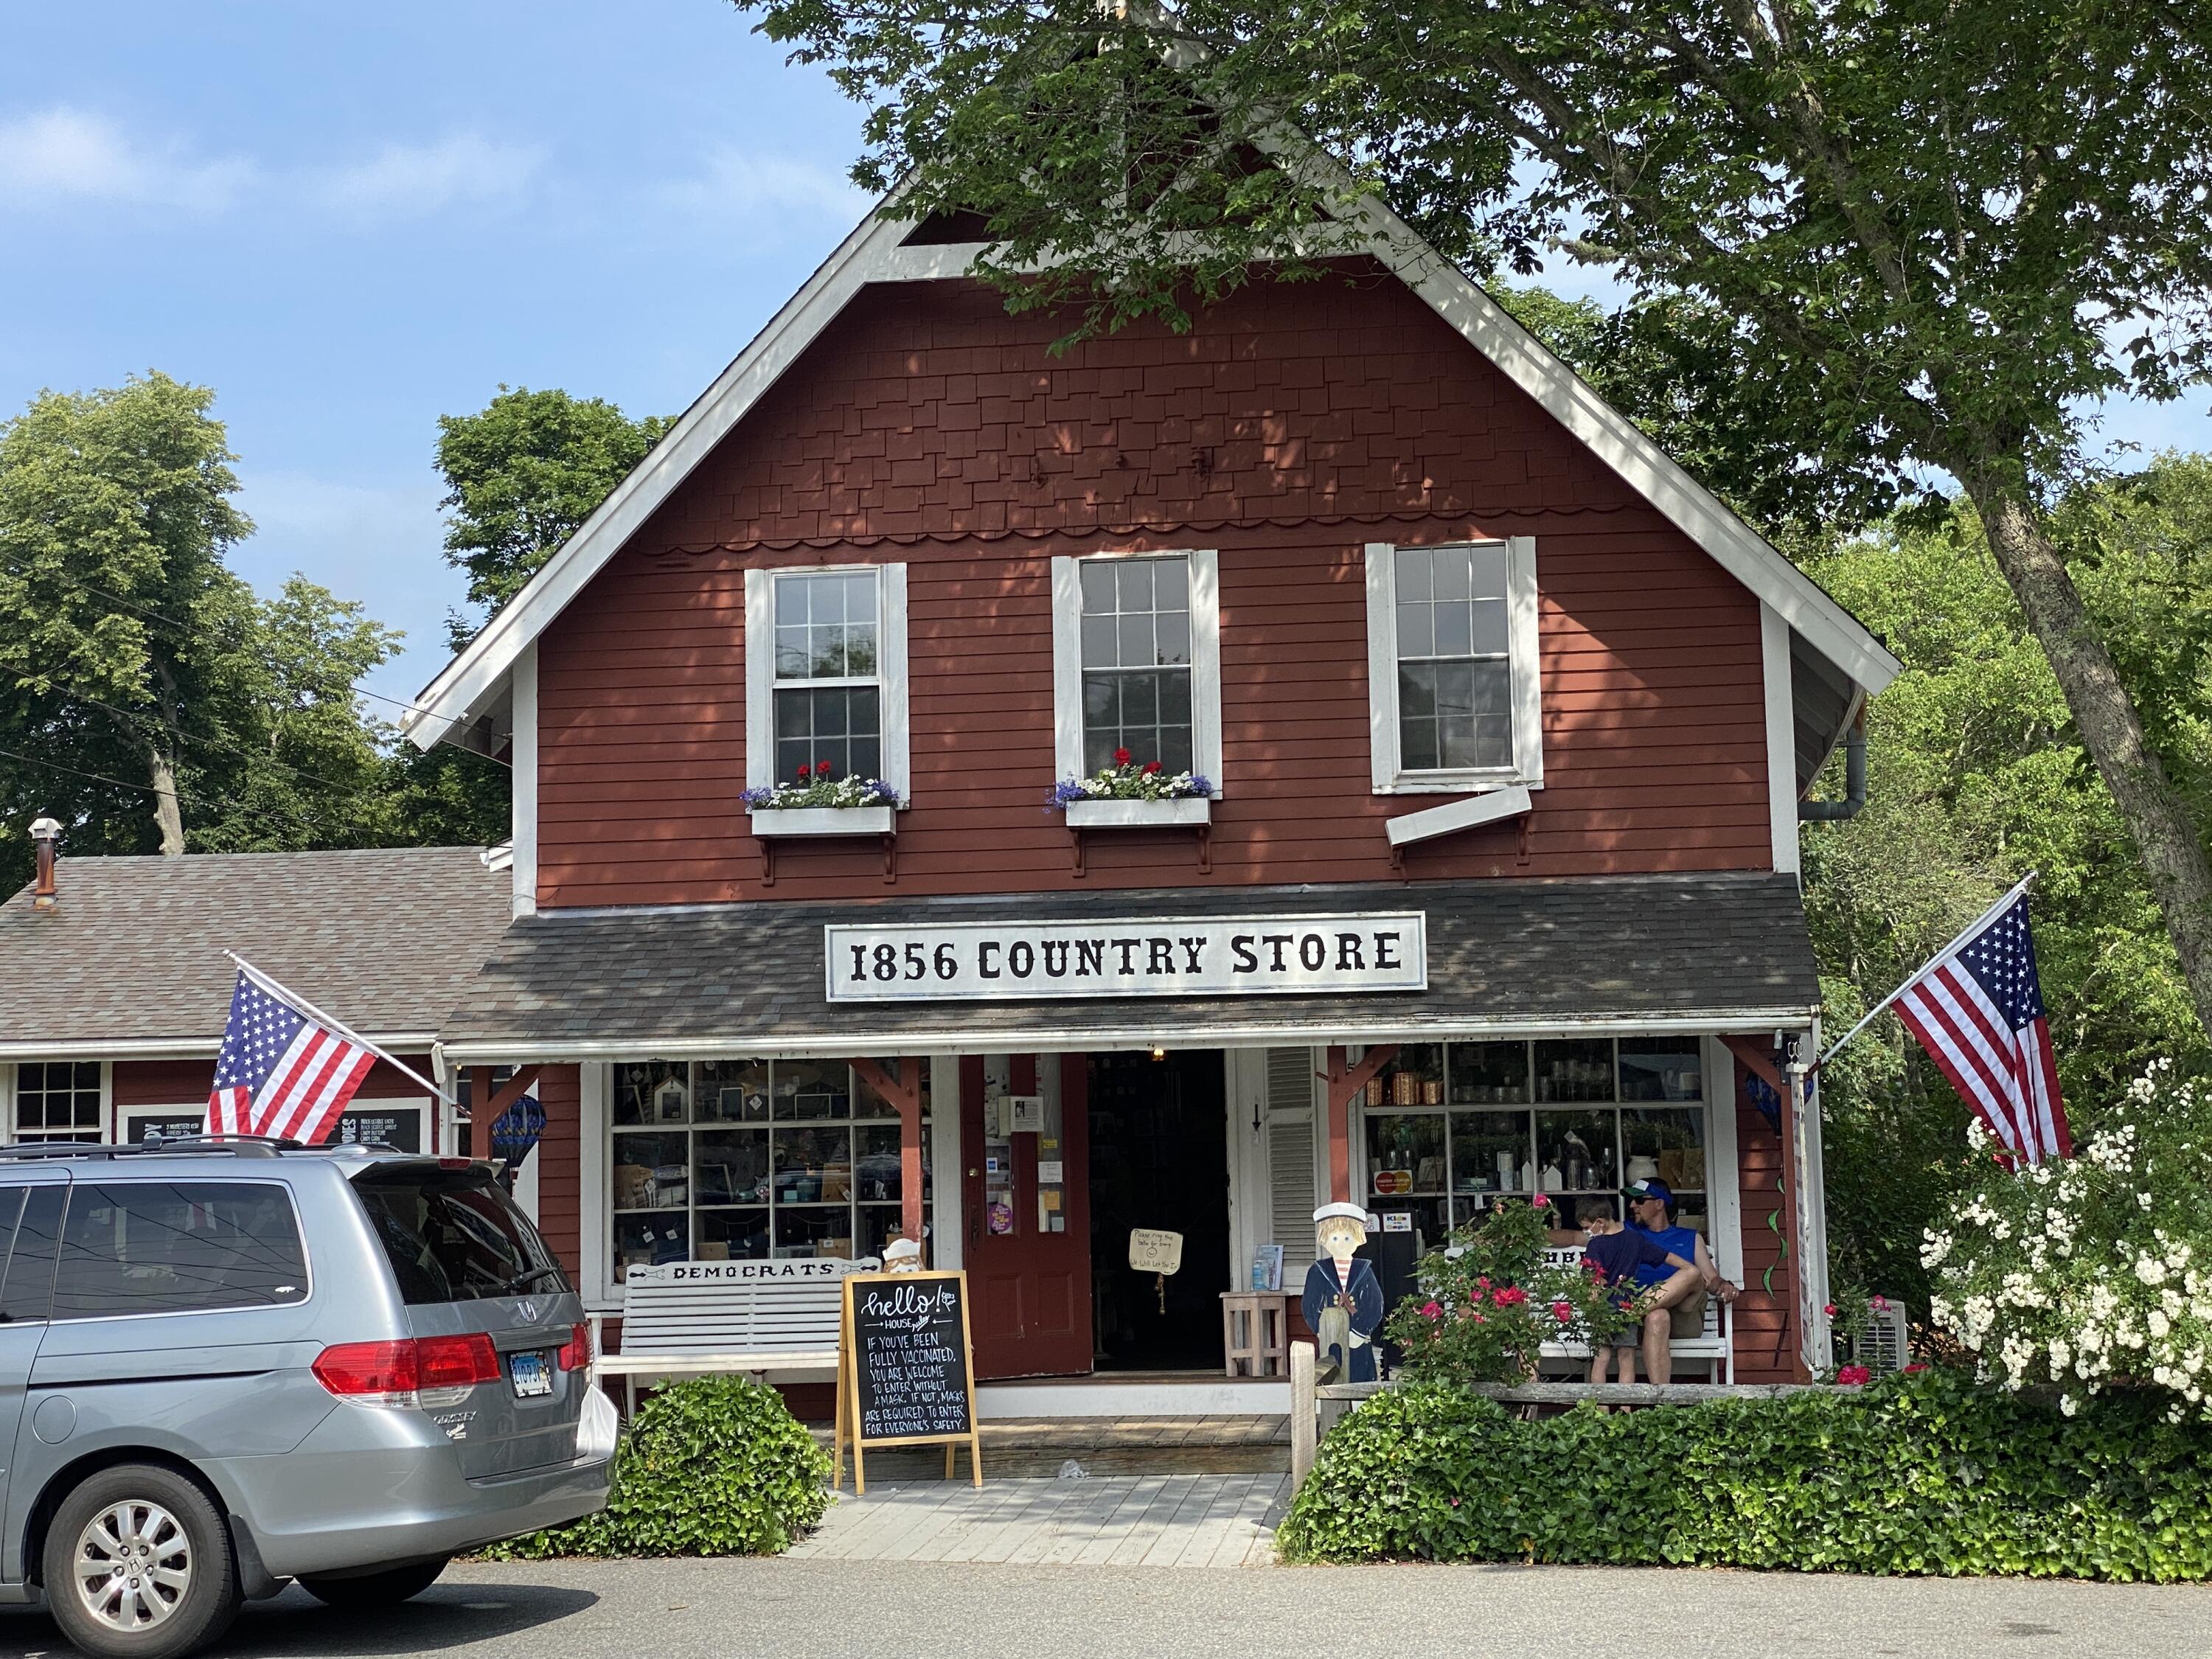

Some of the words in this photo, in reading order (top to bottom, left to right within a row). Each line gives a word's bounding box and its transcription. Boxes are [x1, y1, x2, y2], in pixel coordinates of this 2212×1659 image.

[851, 942, 959, 981] 1856
[978, 937, 1207, 978] COUNTRY
[1231, 932, 1402, 974] STORE
[673, 1264, 835, 1279] DEMOCRATS
[860, 1284, 942, 1316] hello!
[885, 1318, 912, 1329] HOUSE
[867, 1337, 876, 1350] IF
[879, 1335, 910, 1349] YOU'VE
[914, 1332, 939, 1346] BEEN
[869, 1352, 897, 1367] FULLY
[870, 1369, 886, 1382] YOU
[888, 1367, 903, 1380] ARE
[905, 1365, 945, 1382] WELCOME
[872, 1383, 882, 1394] TO
[885, 1381, 911, 1393] ENTER
[914, 1380, 948, 1392] WITHOUT
[874, 1396, 880, 1408] A
[881, 1393, 907, 1408] MASK.
[911, 1392, 919, 1403] IF
[865, 1410, 880, 1422] ARE
[883, 1405, 924, 1421] REQUIRED
[927, 1405, 937, 1417] TO
[939, 1404, 965, 1417] ENTER
[866, 1422, 883, 1435] FOR
[885, 1419, 929, 1433] EVERYONE'S
[933, 1419, 965, 1430] SAFETY.
